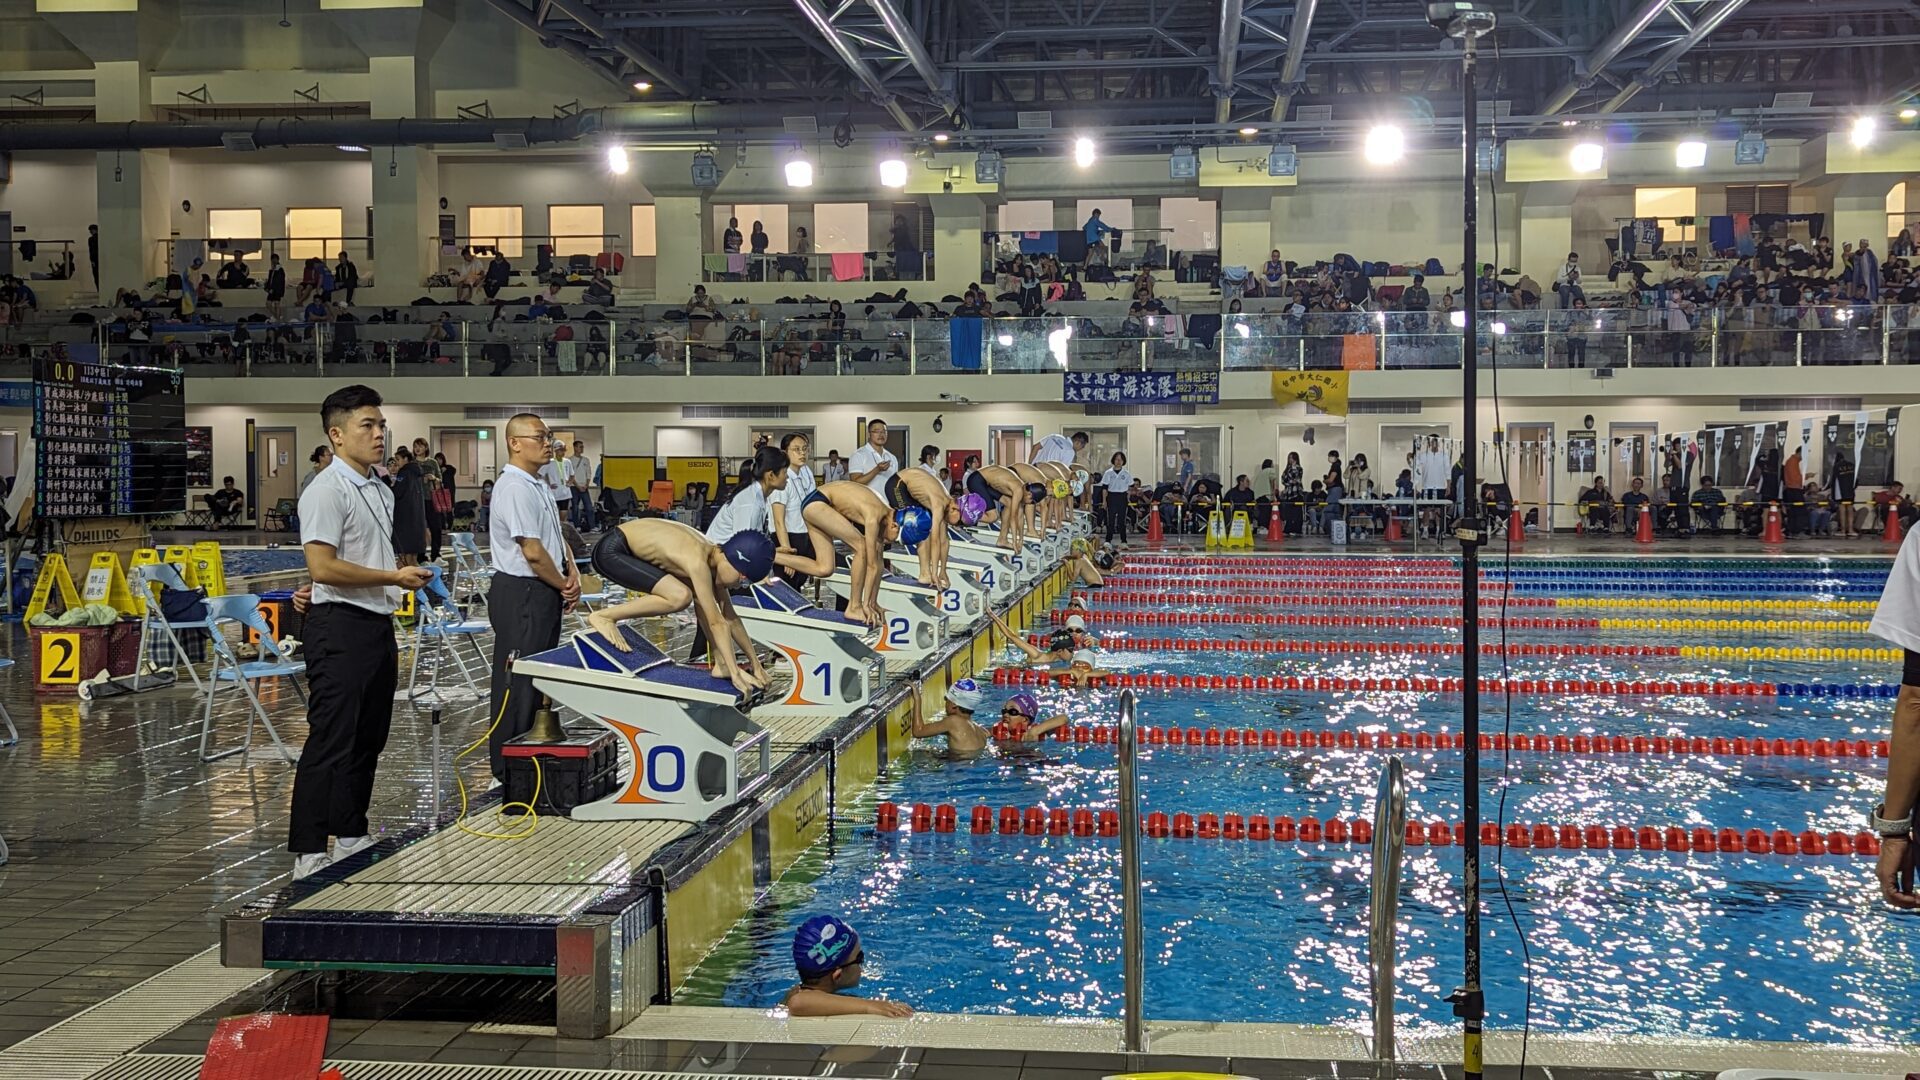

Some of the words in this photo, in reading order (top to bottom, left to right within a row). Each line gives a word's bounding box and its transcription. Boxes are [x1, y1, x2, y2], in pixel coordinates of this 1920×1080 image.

[55, 362, 74, 380] 0.0
[1176, 372, 1218, 383] 熱情招生中
[171, 372, 180, 385] 55
[1066, 372, 1120, 385] 大里高中
[1282, 372, 1338, 390] 台中市大仁國小
[36, 387, 41, 396] 0
[1123, 375, 1174, 398] 游泳隊
[1066, 387, 1120, 401] 大里假期
[36, 400, 40, 409] 1
[36, 412, 41, 422] 2
[36, 426, 41, 435] 3
[38, 442, 43, 452] 4
[38, 454, 43, 464] 5
[38, 467, 42, 476] 6
[38, 480, 42, 490] 7
[38, 492, 42, 502] 8
[38, 506, 42, 515] 9
[74, 529, 121, 544] PHILIPS
[1011, 556, 1023, 571] 5
[90, 575, 107, 584] 禁止
[980, 570, 996, 588] 4
[86, 586, 104, 596] 跳水
[944, 590, 960, 612] 3
[890, 618, 910, 644] 2
[48, 638, 75, 678] 2
[813, 662, 831, 696] 1
[648, 744, 684, 792] 0
[796, 786, 822, 834] SEIKO
[1472, 1044, 1478, 1058] 4
